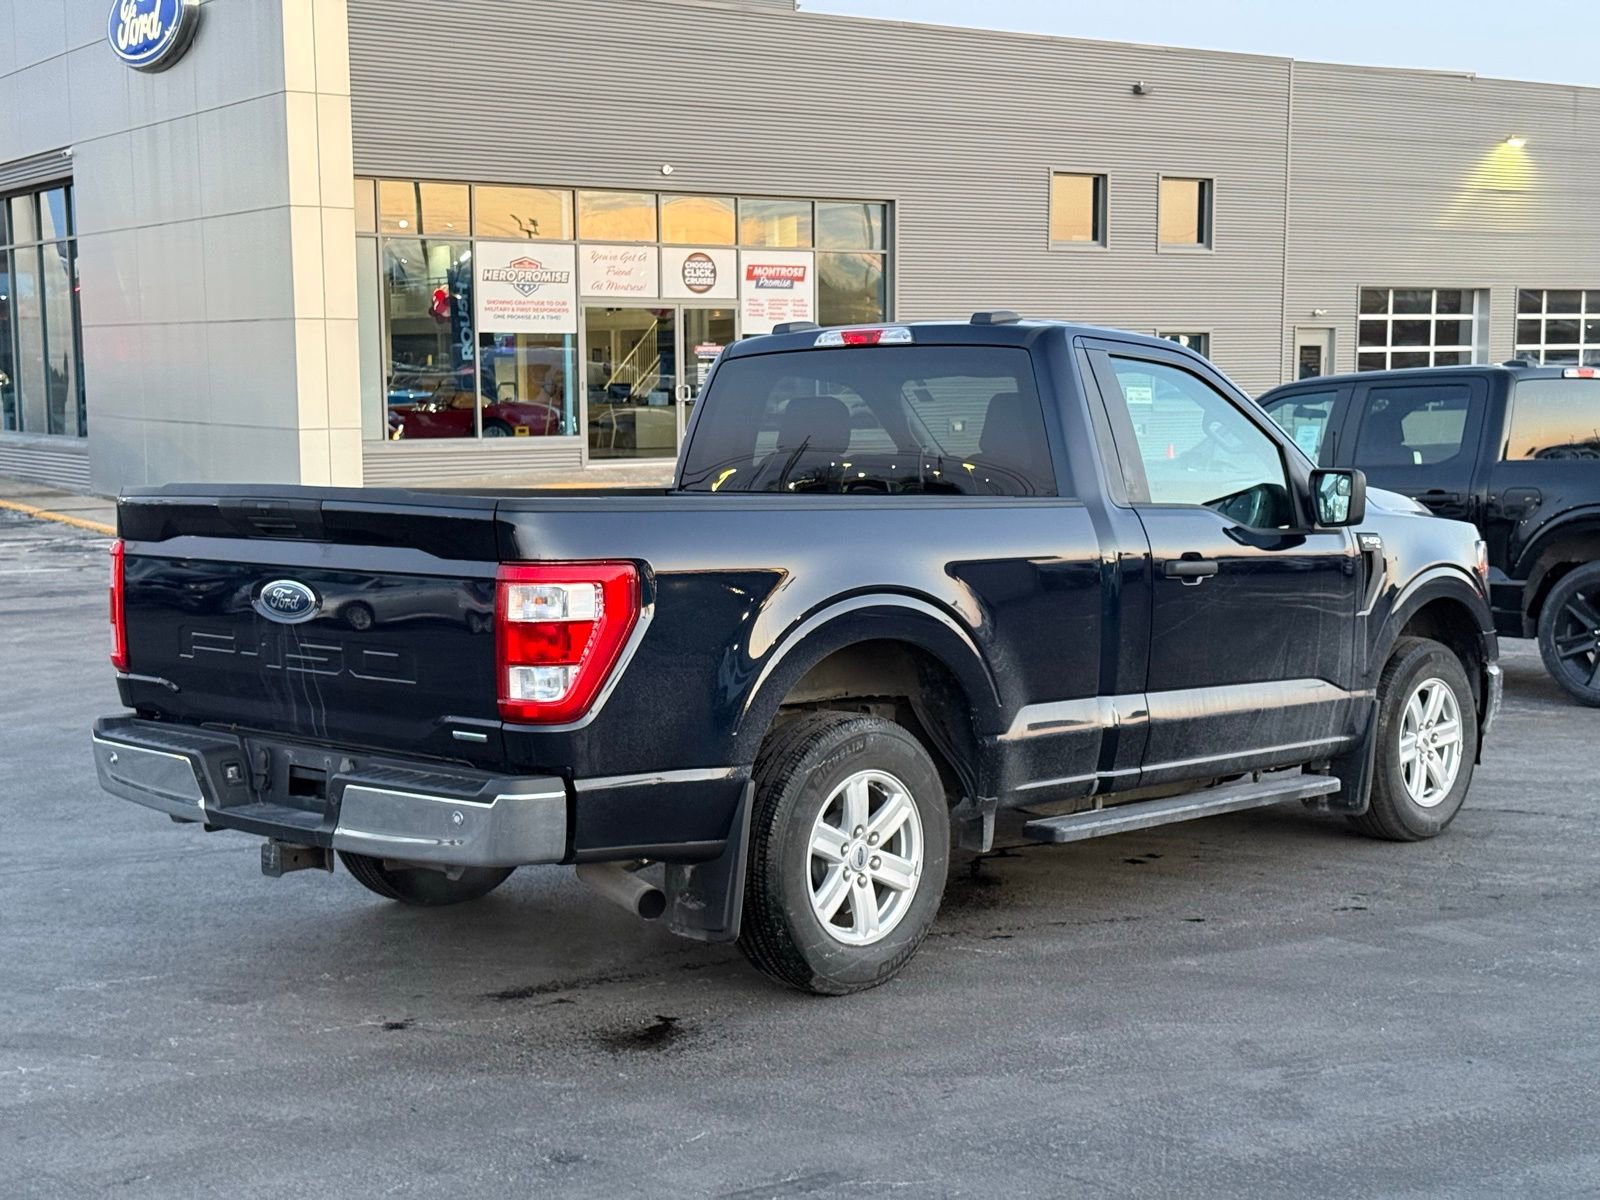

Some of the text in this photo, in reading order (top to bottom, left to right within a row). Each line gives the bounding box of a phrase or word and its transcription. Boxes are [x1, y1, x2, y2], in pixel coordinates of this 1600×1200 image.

[117, 0, 162, 50] Ford
[483, 269, 569, 283] HERO PROMISE
[753, 266, 805, 278] MONTROSE
[758, 277, 792, 288] Promise
[455, 281, 474, 360] ROUSH
[270, 587, 300, 610] Ford
